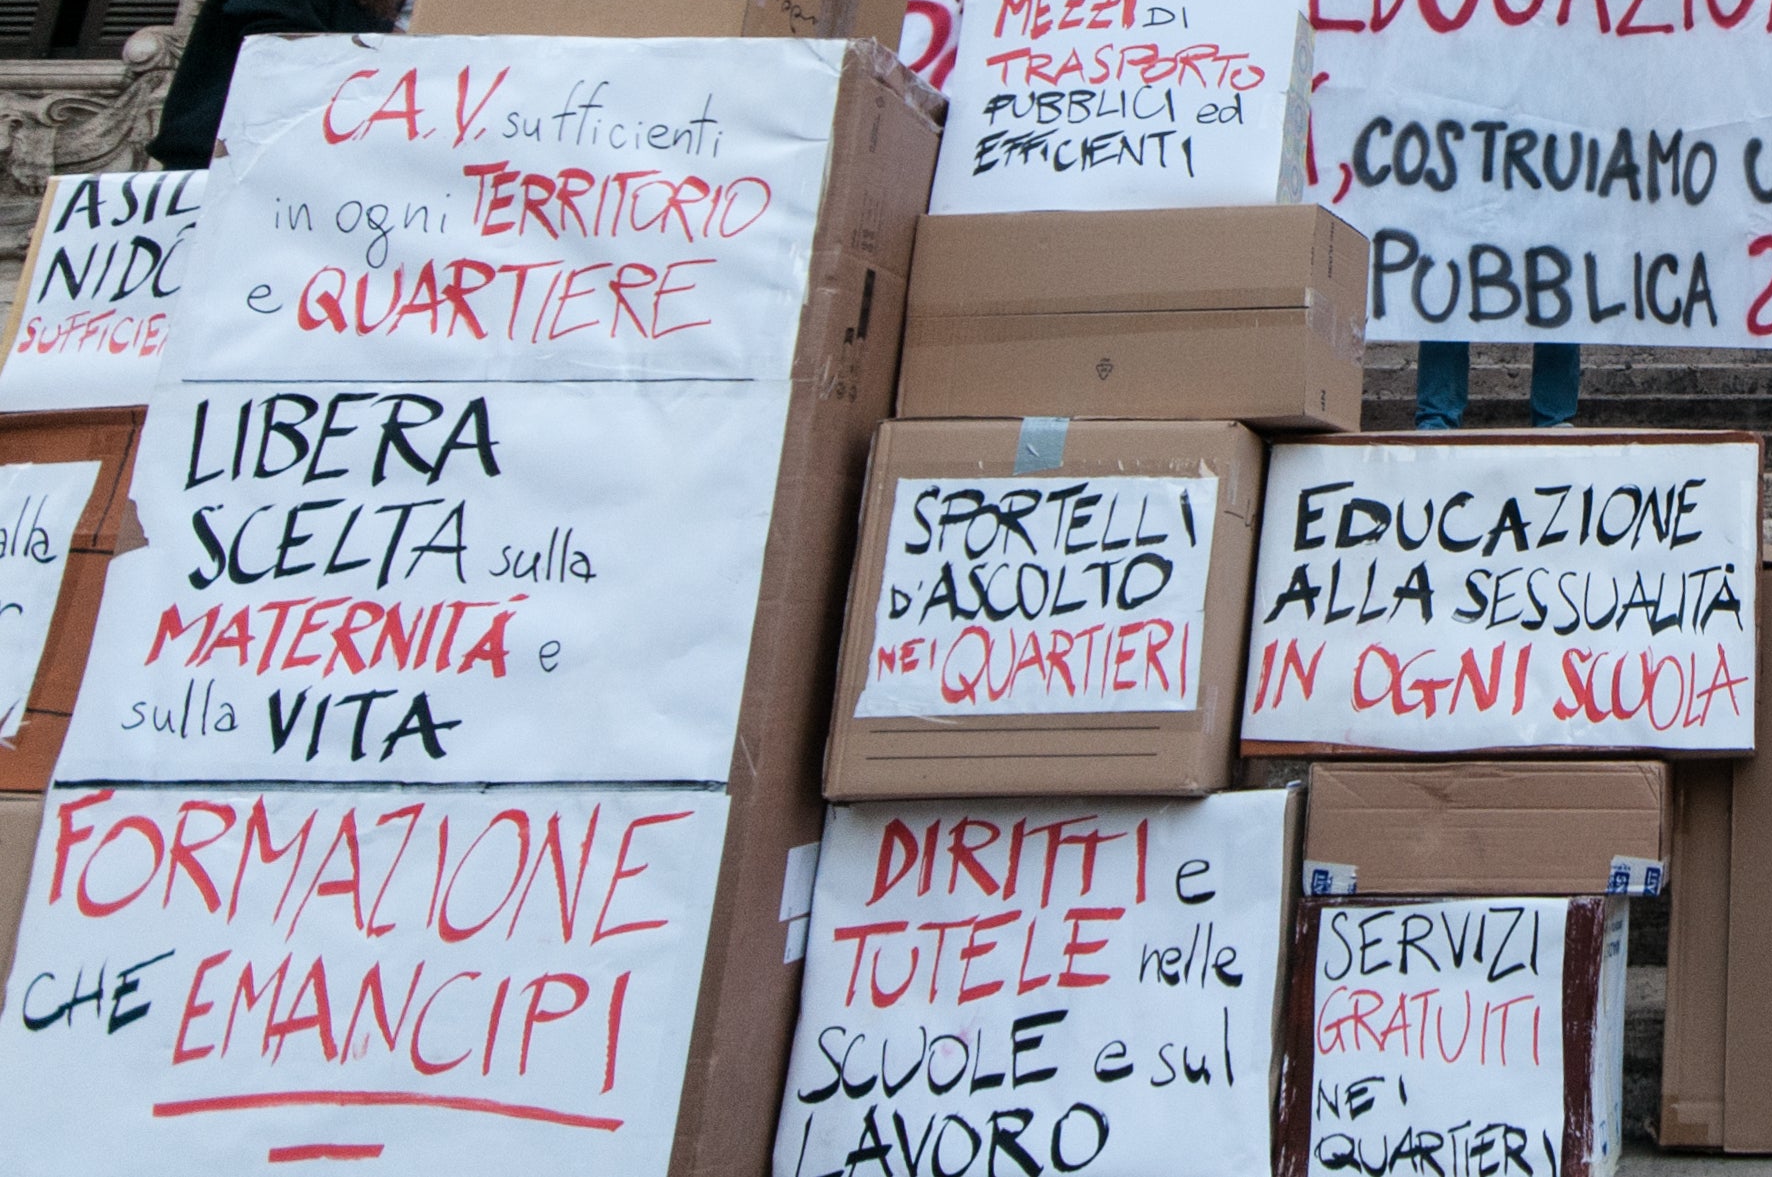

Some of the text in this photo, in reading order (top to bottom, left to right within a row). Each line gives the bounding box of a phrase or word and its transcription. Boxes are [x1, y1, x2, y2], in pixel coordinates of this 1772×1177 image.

[1143, 7, 1188, 28] DI
[983, 88, 1243, 125] PUBBLICI ed
[986, 44, 1265, 91] TRASPORTO
[502, 80, 724, 158] sufficienti
[973, 129, 1194, 178] EFFICIENTI
[273, 196, 323, 234] in
[336, 194, 451, 268] ogni
[463, 160, 772, 243] TERRITORIO
[247, 258, 717, 344] e QUARTIERE
[1372, 228, 1718, 329] PUBBLICA
[18, 309, 166, 355] SUFFICIE
[184, 392, 501, 491] LIBERA
[188, 498, 597, 590] SCELTA sulla
[905, 482, 1197, 561] SPORTELLI
[1294, 478, 1706, 557] EDUCAZIONE
[889, 552, 1173, 625] D'ASCOLTO
[1263, 558, 1435, 625] ALLA
[539, 640, 561, 673] e
[878, 618, 1189, 704] NEI QUARTIERI
[1253, 638, 1748, 731] IN OGNI SCUOLA
[122, 679, 462, 762] sulla VITA
[49, 789, 697, 946] FORMAZIONE
[866, 814, 1216, 909] DIRITTI e
[834, 907, 1243, 1008] TUTELE nelle
[1324, 906, 1539, 983] SERVIZI
[23, 949, 631, 1093] CHE EMANCIPI
[797, 1007, 1234, 1104] SCUOLE e sul
[1317, 986, 1540, 1065] GRATUITI
[1316, 1075, 1408, 1121] NEI
[795, 1102, 1110, 1177] LAVORO
[1314, 1120, 1557, 1177] QUARTIERI
